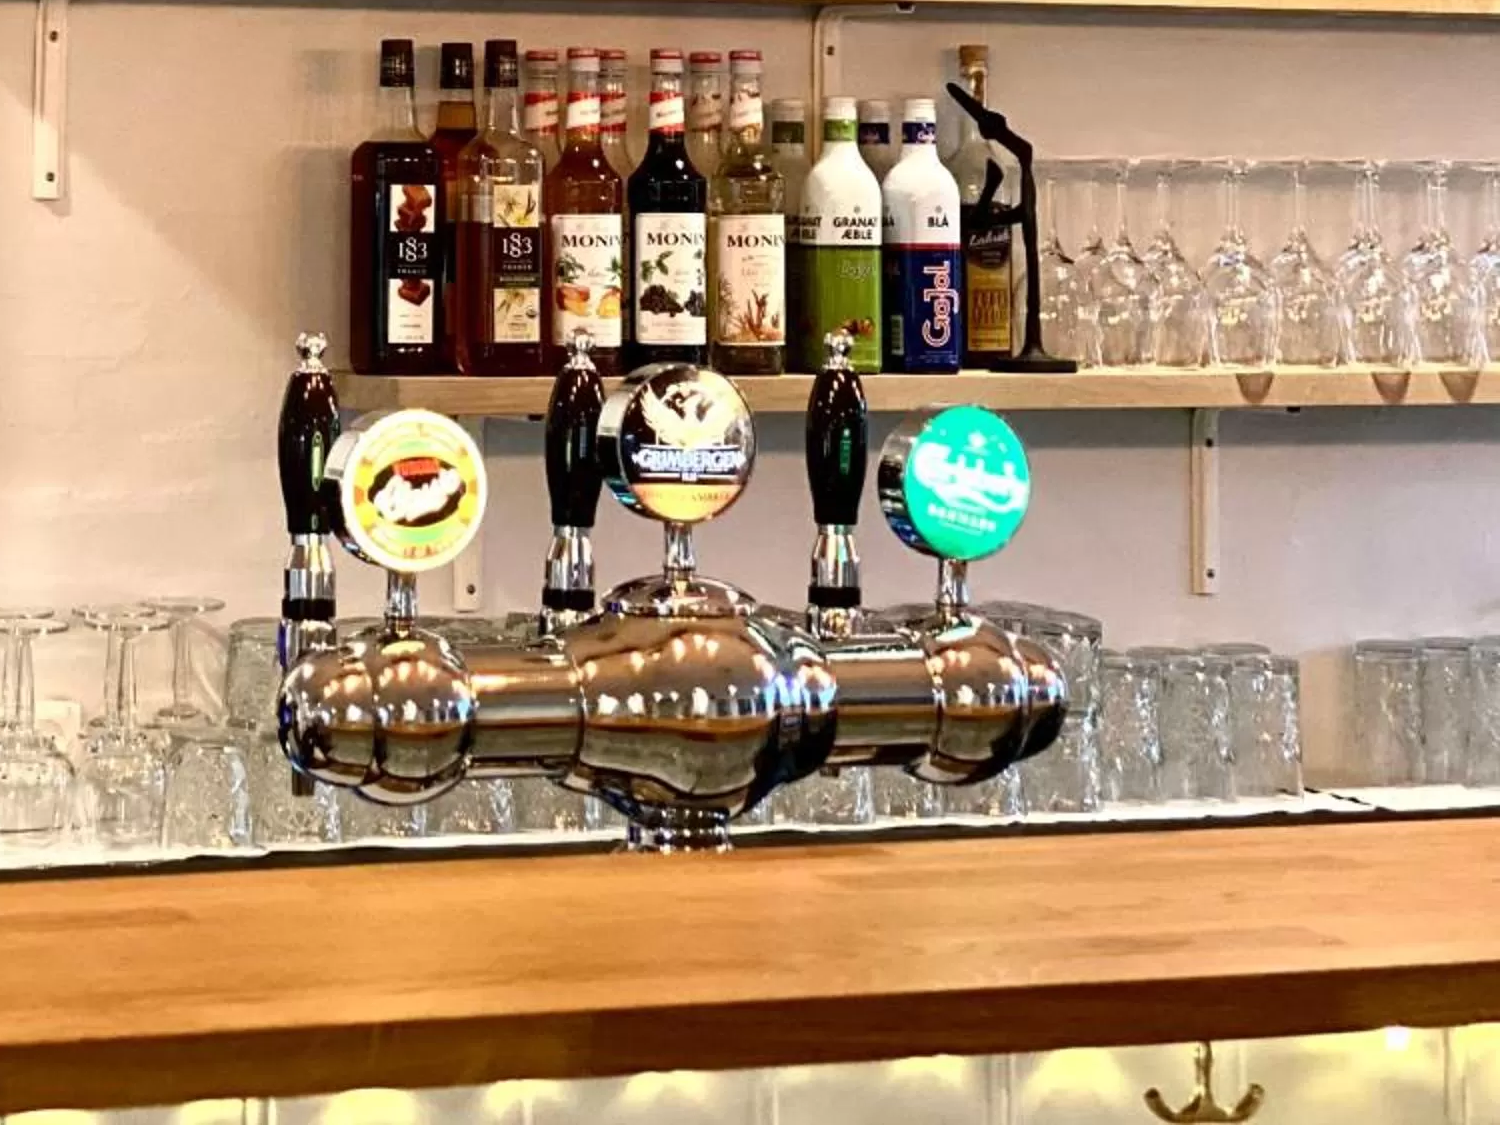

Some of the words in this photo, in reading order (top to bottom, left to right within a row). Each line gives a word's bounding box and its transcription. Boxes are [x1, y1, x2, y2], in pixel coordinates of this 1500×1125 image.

[928, 215, 950, 228] BLÅ
[841, 229, 872, 240] ÆBLE
[640, 448, 739, 472] GRIMBERGEN
